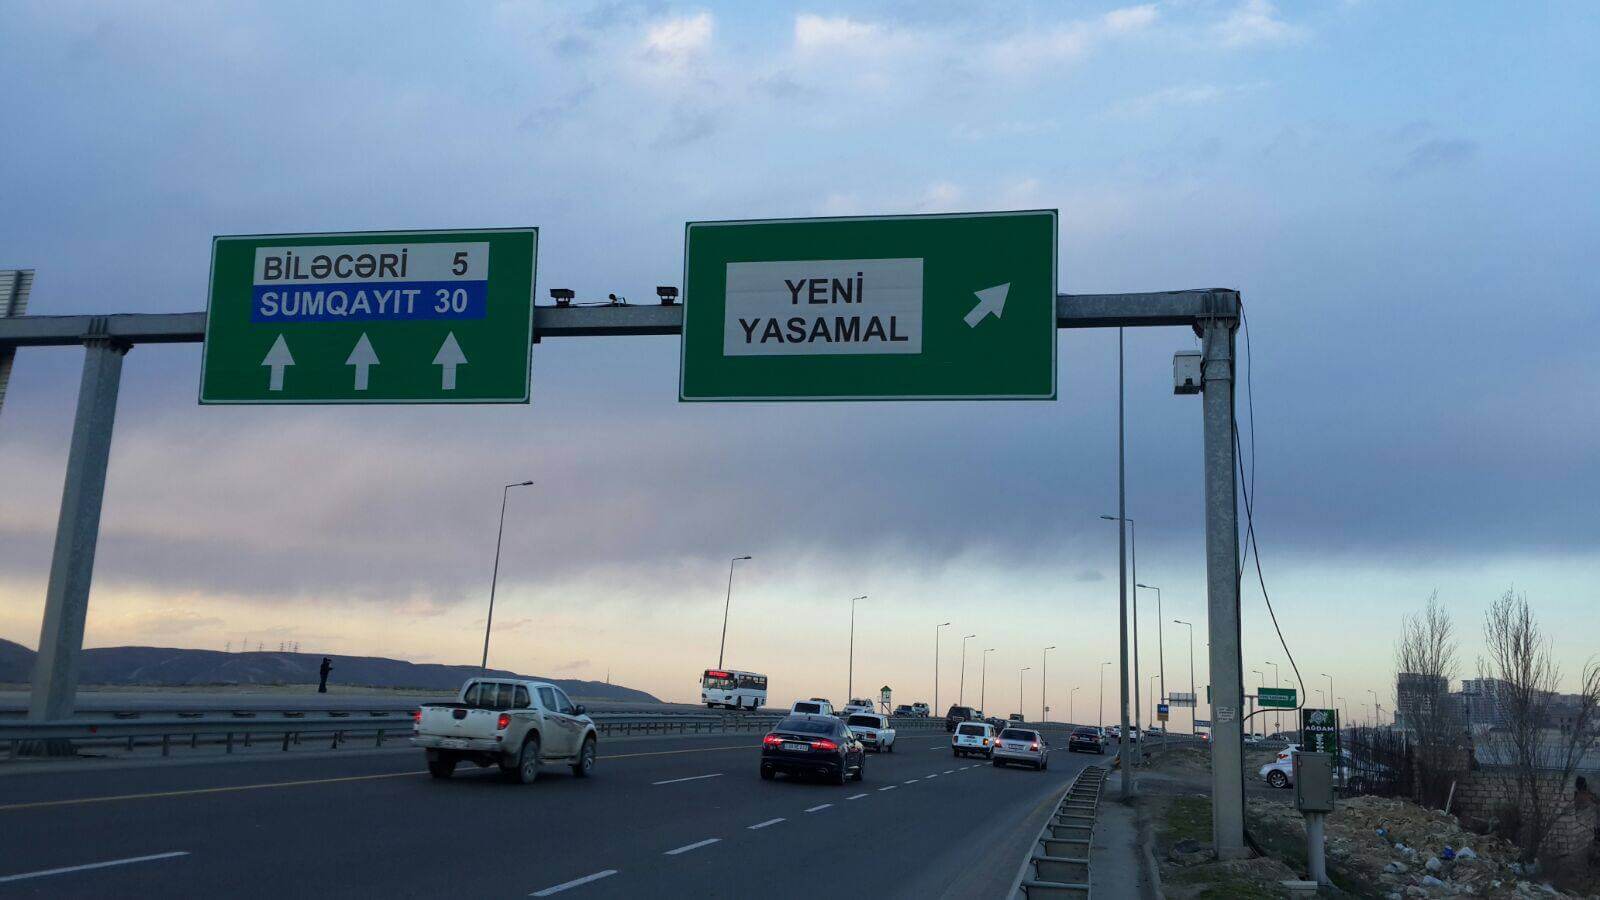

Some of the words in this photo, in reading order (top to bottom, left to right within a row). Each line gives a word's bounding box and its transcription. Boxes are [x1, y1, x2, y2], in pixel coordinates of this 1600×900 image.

[264, 248, 408, 281] BİLƏCƏRİ
[452, 252, 469, 276] 5
[260, 289, 421, 316] SUMQAYIT
[434, 288, 468, 314] 30
[784, 271, 864, 305] YENİ
[738, 316, 909, 344] YASAMAL
